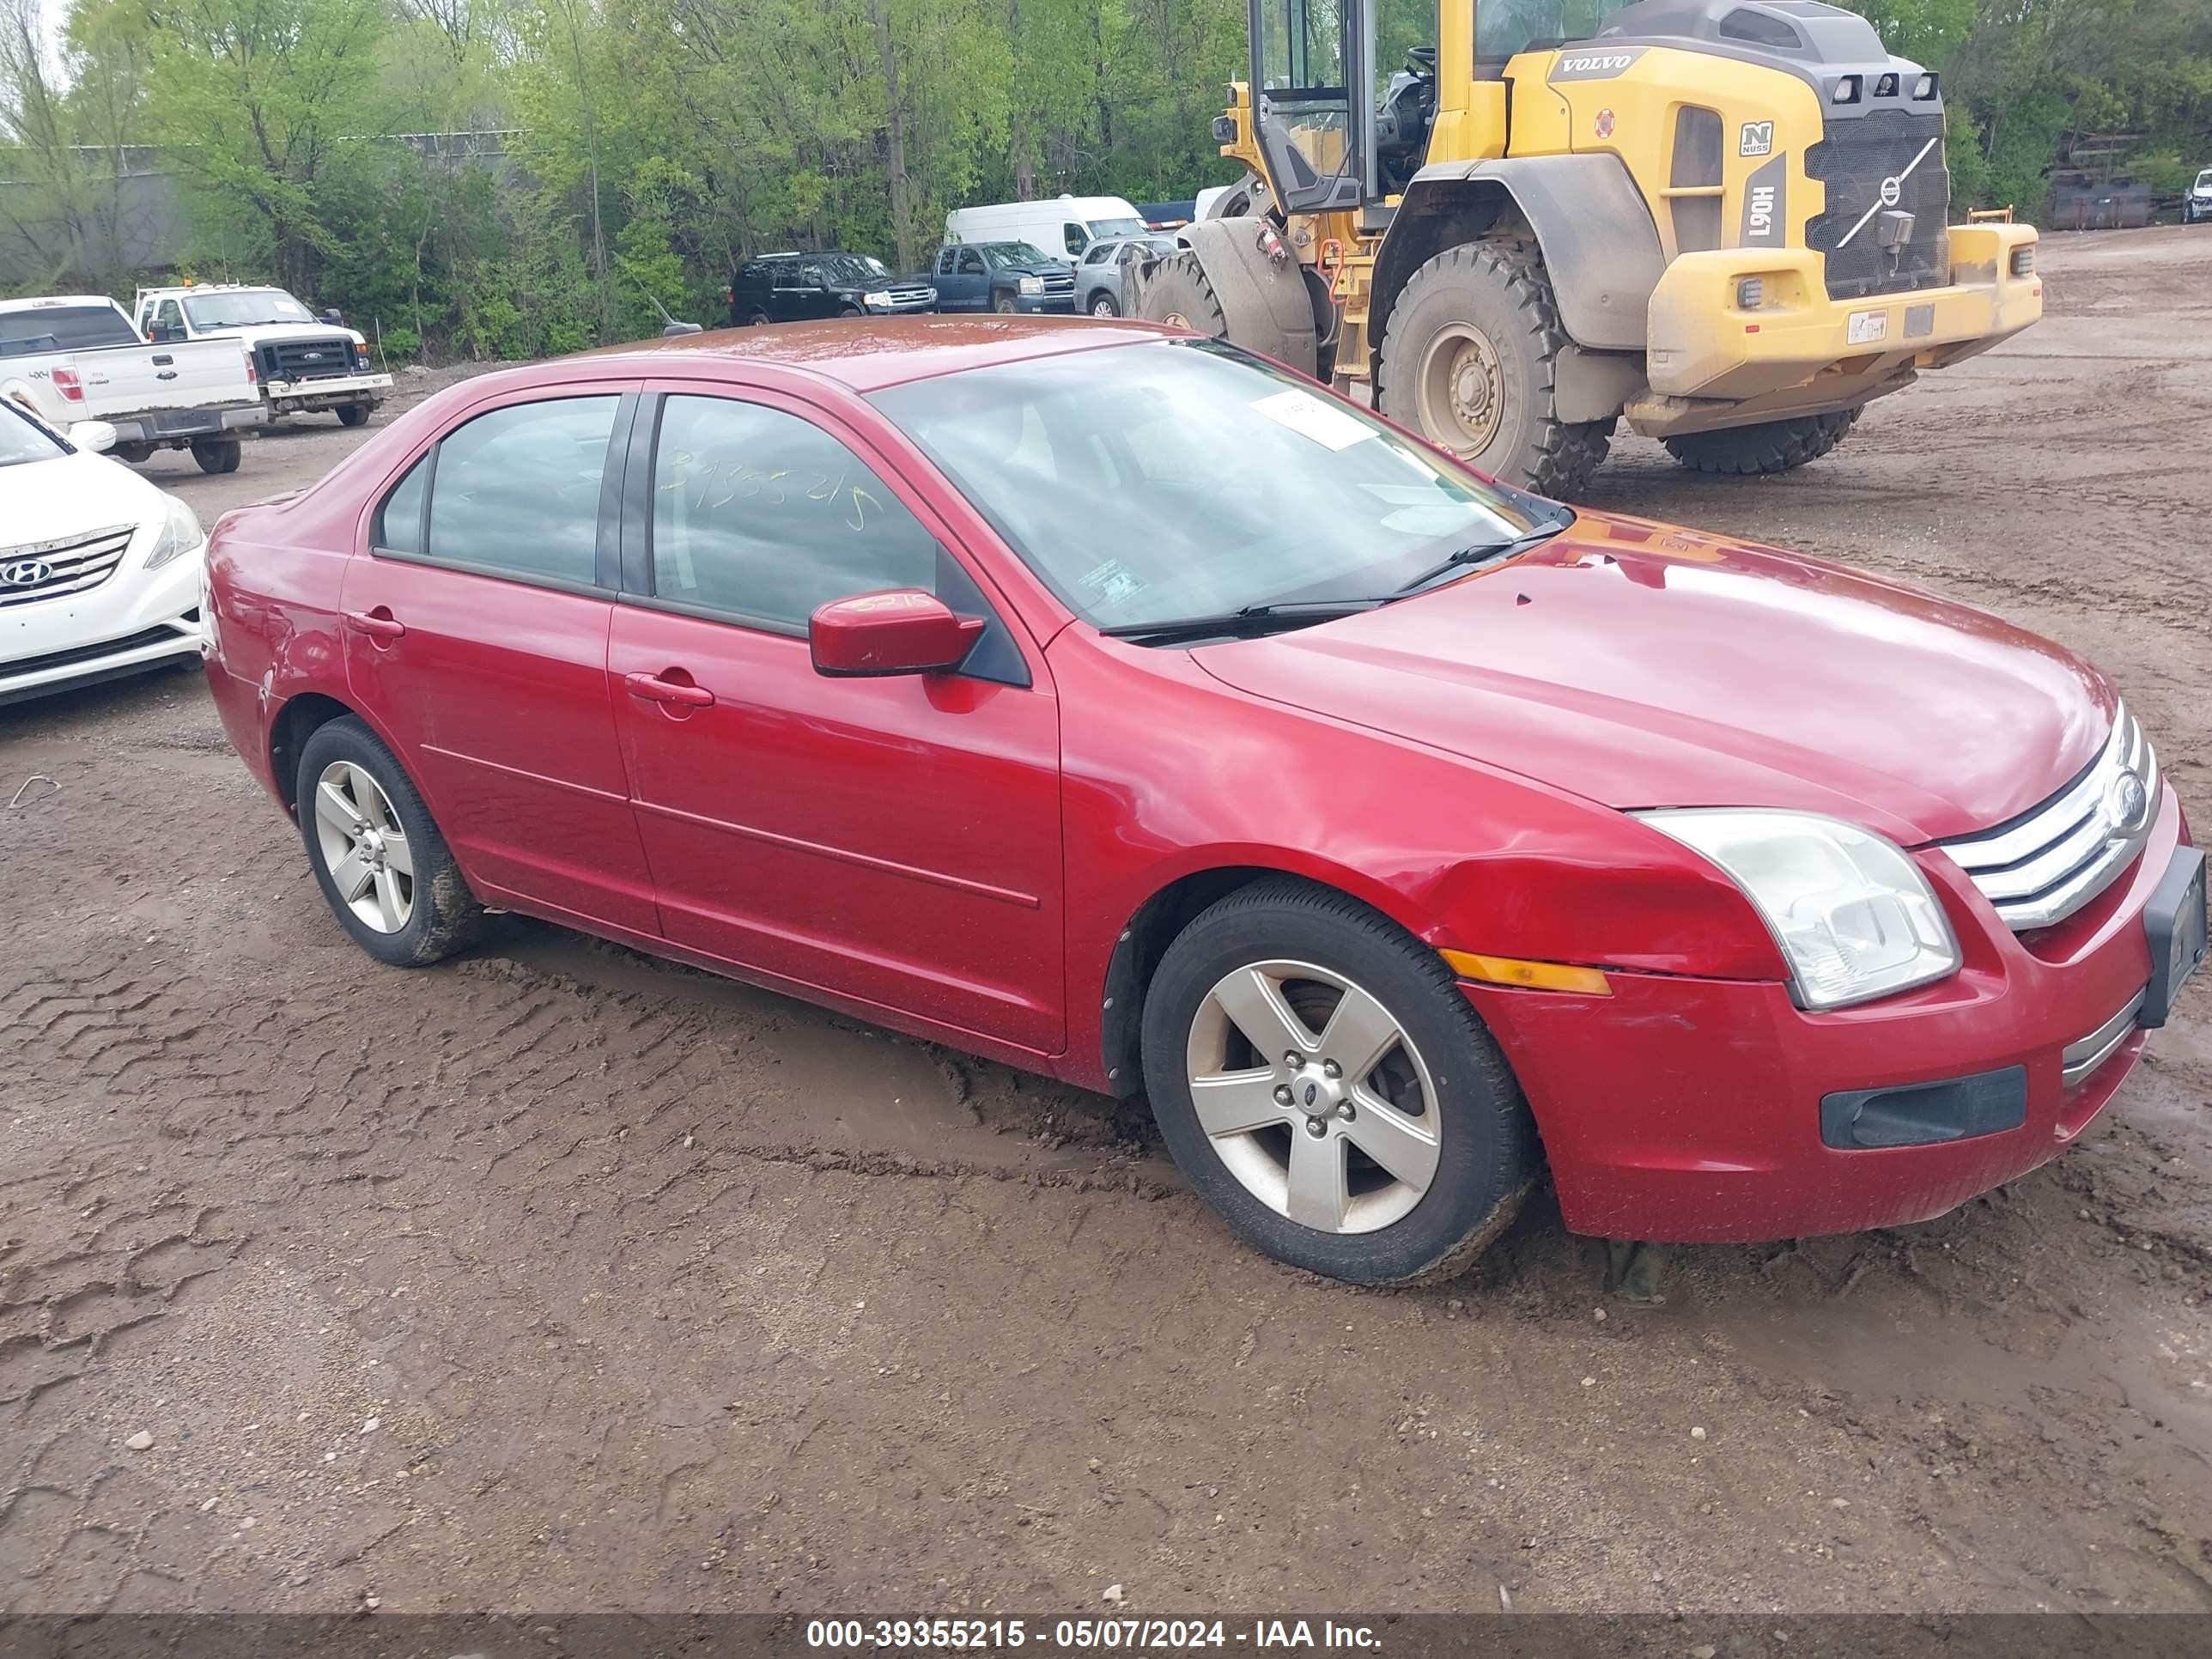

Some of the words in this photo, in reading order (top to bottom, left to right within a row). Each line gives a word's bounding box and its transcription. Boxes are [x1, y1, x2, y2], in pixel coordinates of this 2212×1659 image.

[1563, 56, 1631, 72] VOLVO
[1743, 125, 1770, 146] N
[1742, 144, 1768, 154] NUSS
[1748, 186, 1774, 236] L90H
